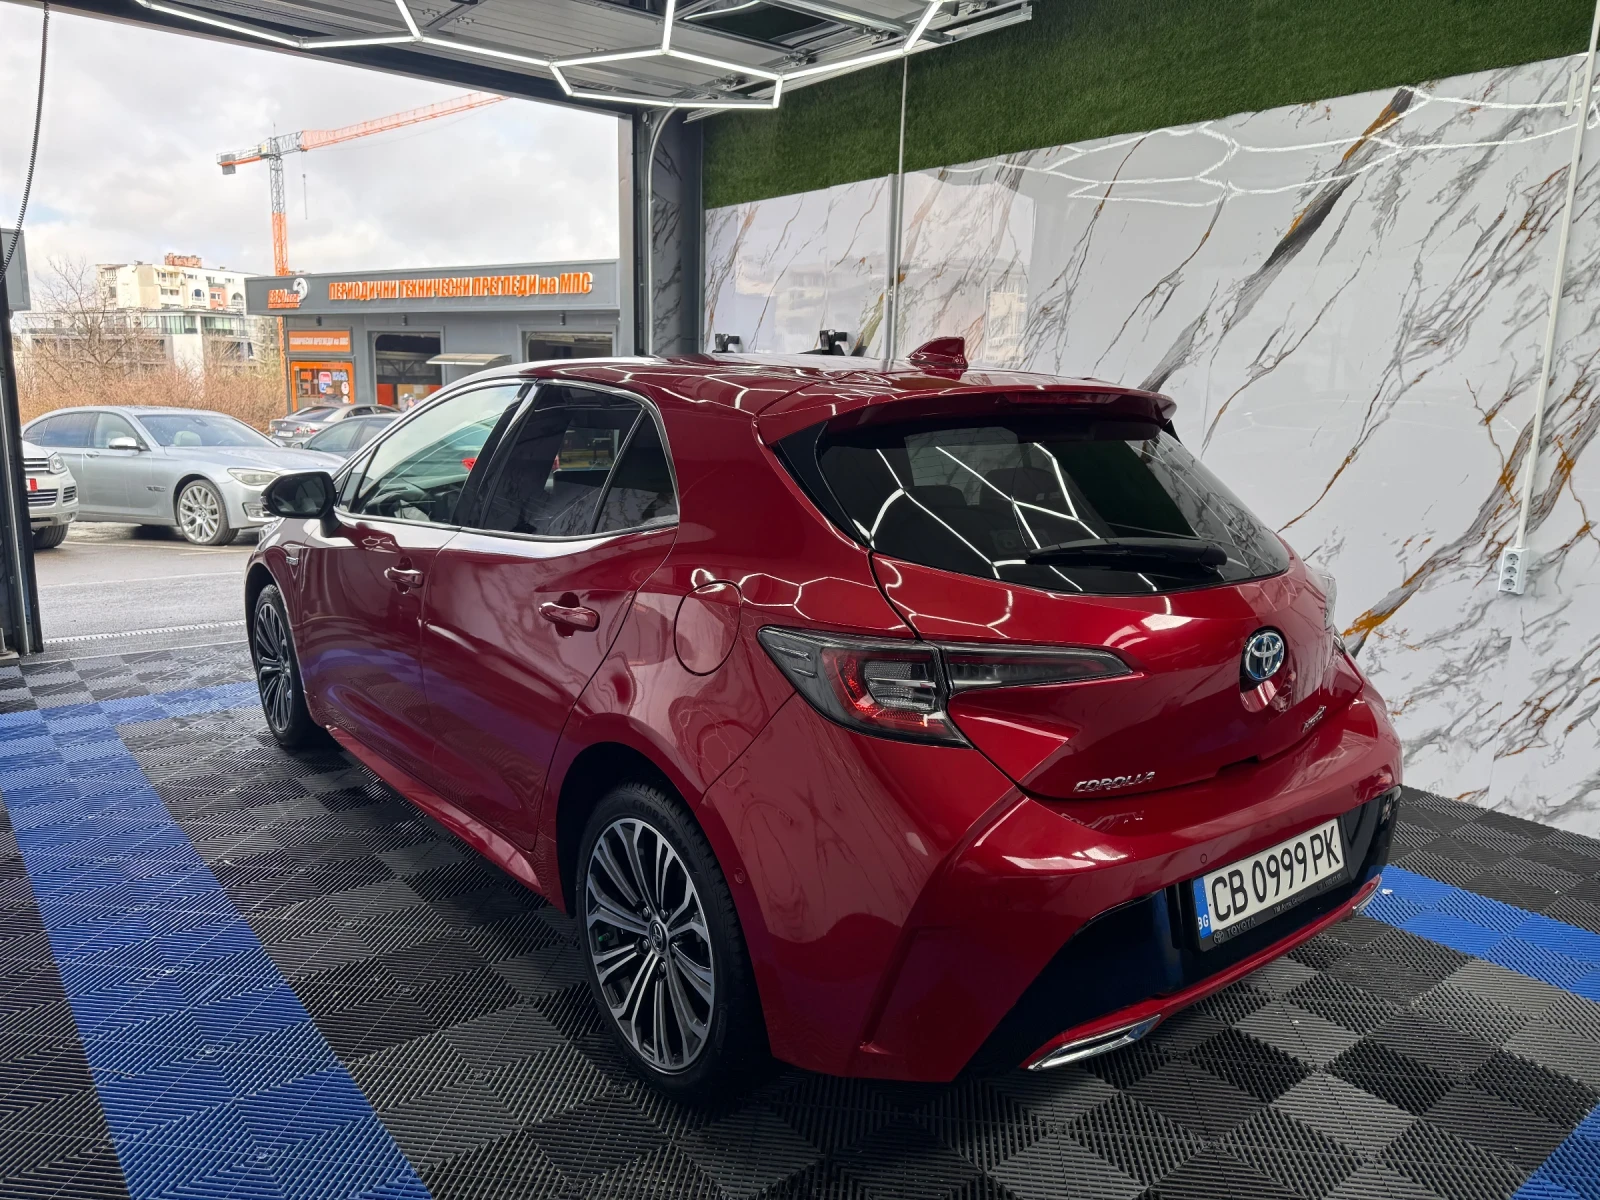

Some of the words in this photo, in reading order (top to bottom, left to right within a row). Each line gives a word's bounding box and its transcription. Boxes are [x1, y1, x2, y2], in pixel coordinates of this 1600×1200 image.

[329, 281, 399, 300] ПЕРИОДИЧНИ
[400, 278, 472, 297] ТЕХНИЧЕСКИ
[473, 275, 539, 297] ПРЕГЛЕДИ
[540, 277, 559, 294] на
[560, 272, 593, 294] МПС
[1073, 771, 1156, 792] COROLLA
[1211, 869, 1248, 922] CB
[1251, 841, 1307, 903] 0999
[1309, 825, 1341, 876] PK
[1226, 917, 1256, 937] TOYOTA
